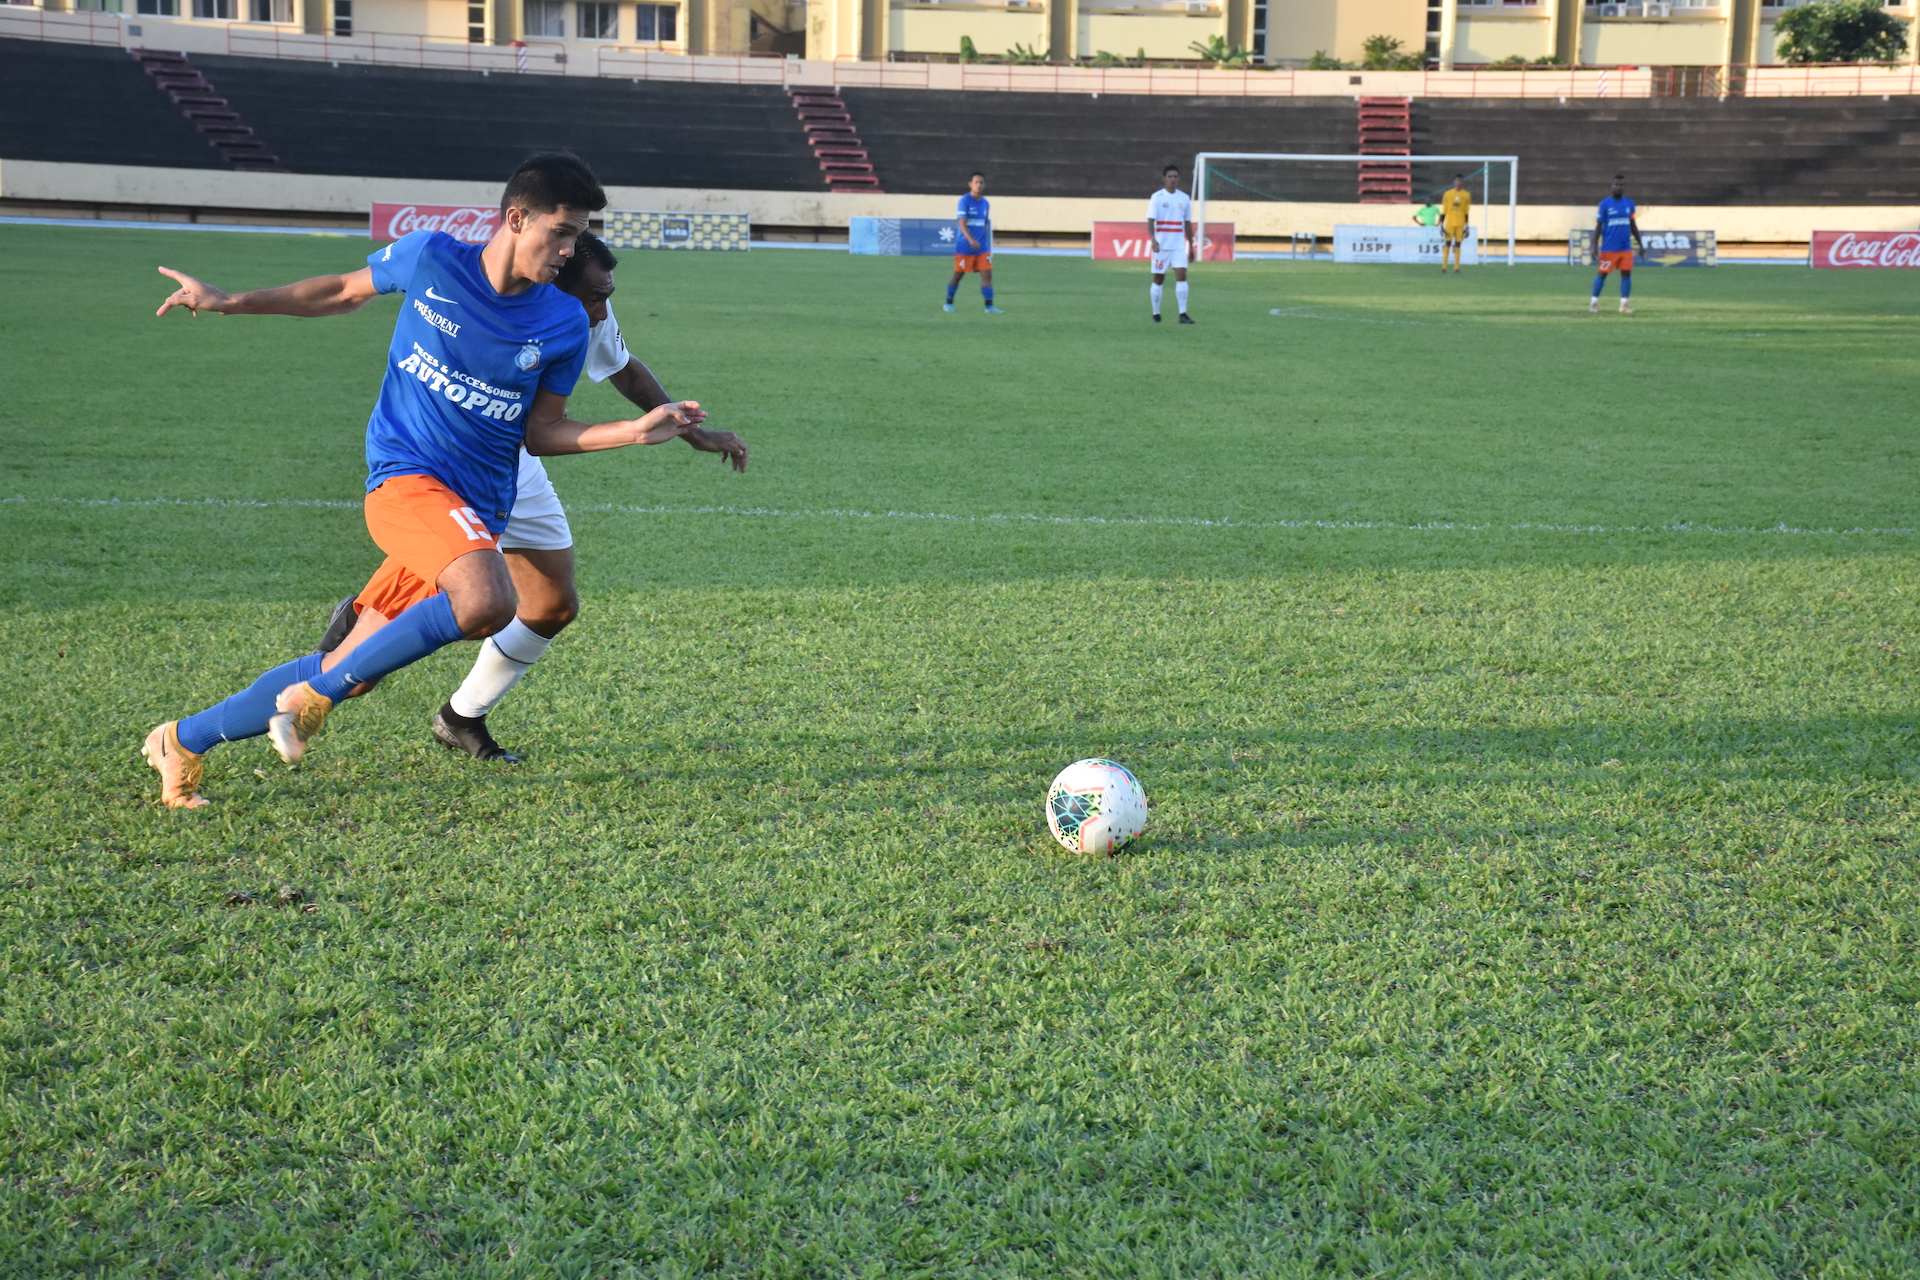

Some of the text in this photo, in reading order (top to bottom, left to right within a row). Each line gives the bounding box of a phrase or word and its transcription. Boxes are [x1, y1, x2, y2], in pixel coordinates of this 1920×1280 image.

[388, 206, 499, 242] Coca-Cola
[1641, 232, 1691, 249] rata
[1155, 259, 1164, 270] 16
[1828, 232, 1920, 267] Coca-Col
[397, 353, 523, 422] AUTOPRO
[440, 364, 449, 375] &
[451, 370, 521, 400] ACCESSOIRES
[448, 506, 493, 541] 15
